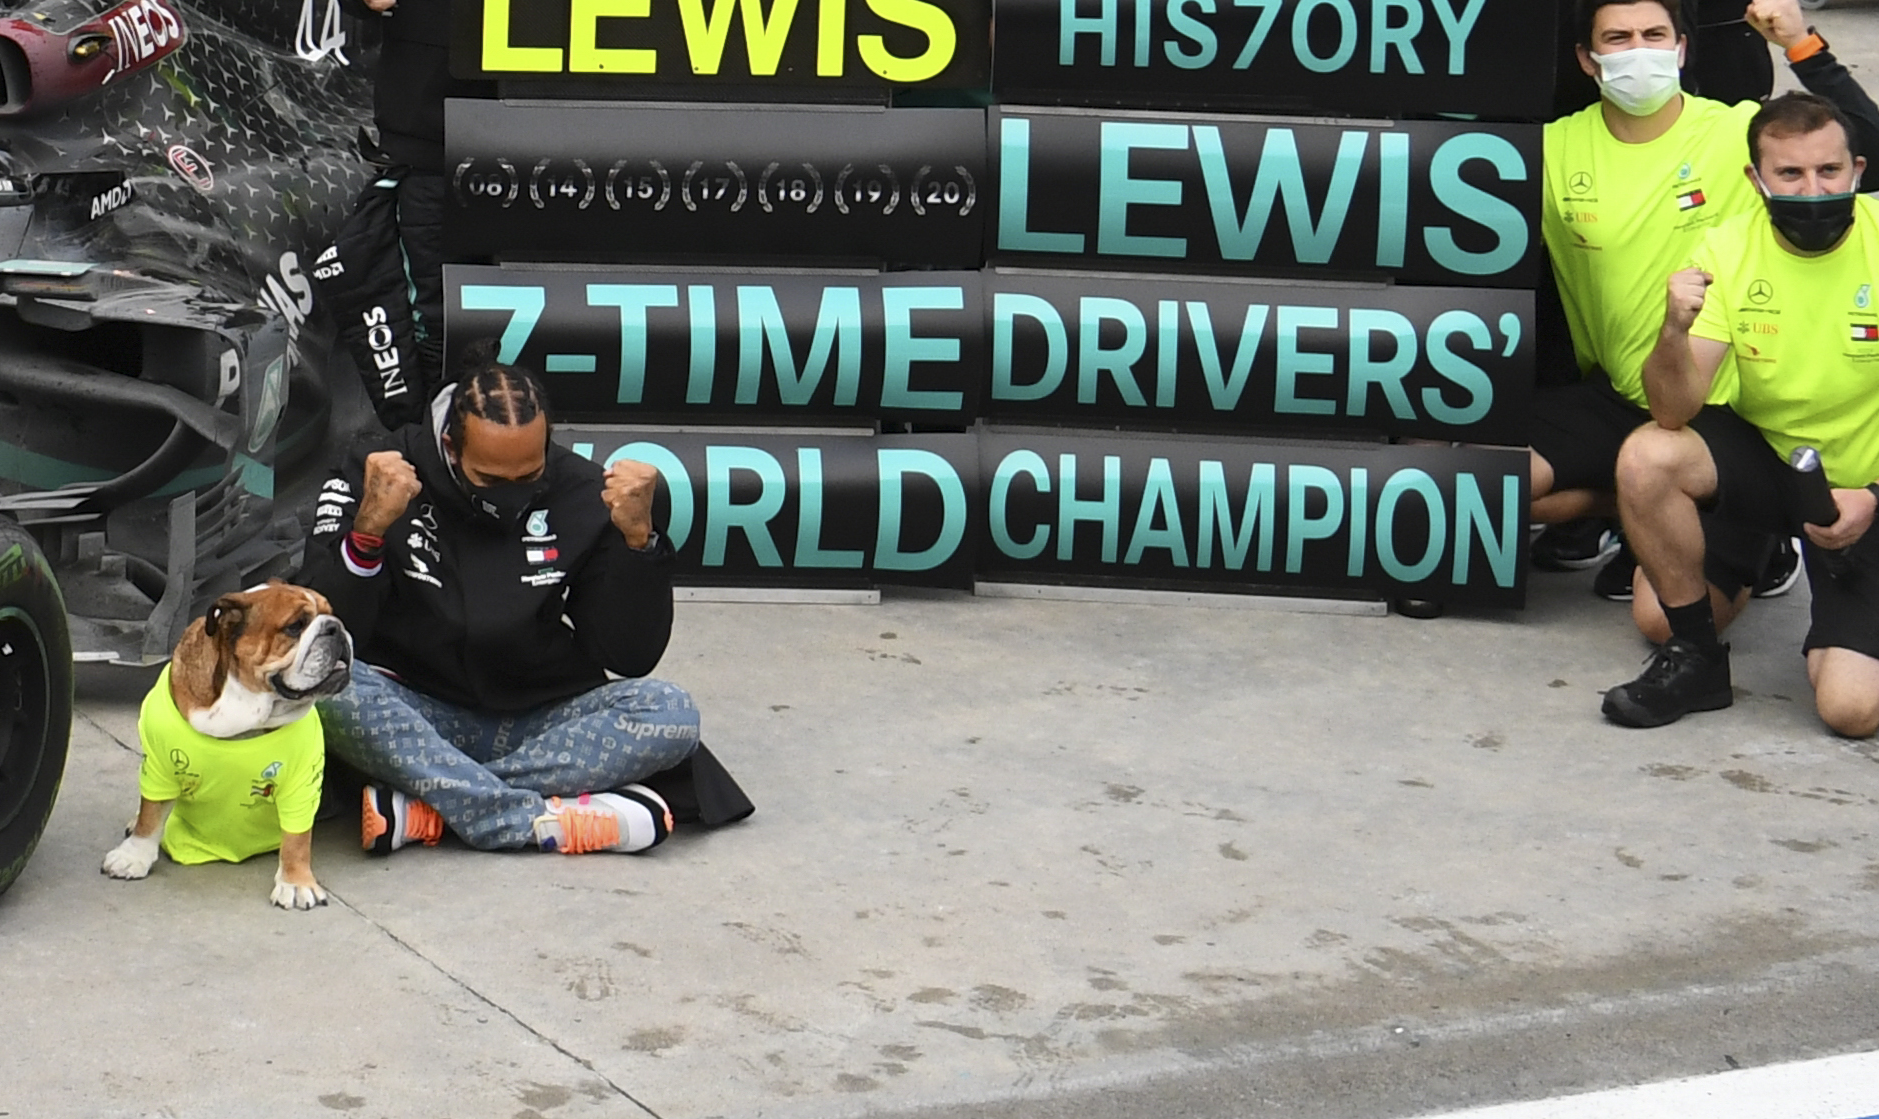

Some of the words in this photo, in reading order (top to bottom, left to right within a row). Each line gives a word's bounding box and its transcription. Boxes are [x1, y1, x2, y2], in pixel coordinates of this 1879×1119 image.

[90, 186, 122, 221] AMD
[546, 174, 578, 198] 14
[623, 175, 655, 199] 15
[699, 175, 729, 200] 17
[775, 178, 807, 202] 18
[851, 179, 883, 203] 19
[926, 180, 961, 205] 20
[998, 121, 1529, 275] LEWIS
[1575, 212, 1598, 223] UBS
[460, 282, 966, 410] 7-TIME
[1752, 322, 1779, 335] UBS
[362, 306, 408, 399] INEOS
[573, 441, 967, 571] ORLD
[989, 452, 1520, 588] CHAMPION
[613, 716, 698, 741] Supreme
